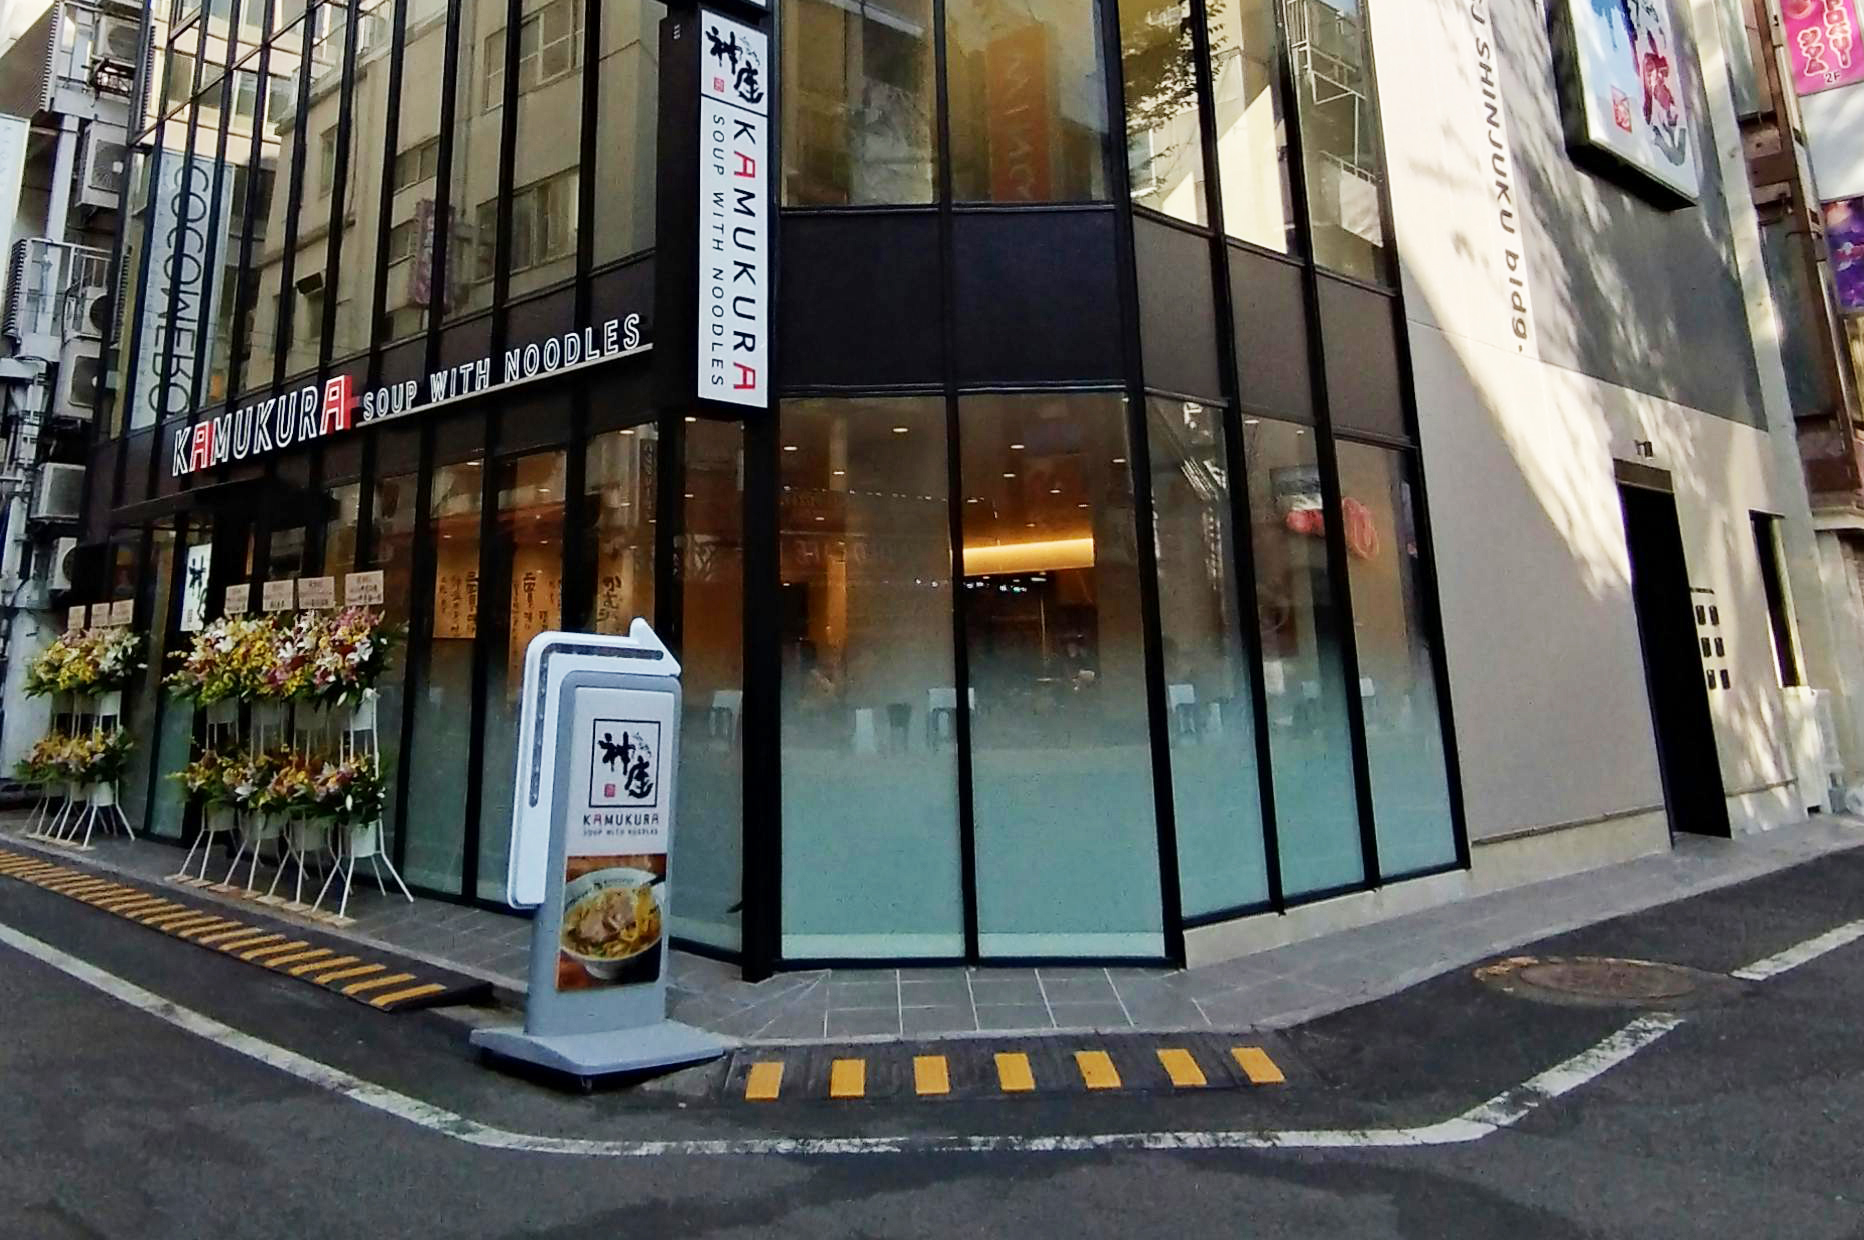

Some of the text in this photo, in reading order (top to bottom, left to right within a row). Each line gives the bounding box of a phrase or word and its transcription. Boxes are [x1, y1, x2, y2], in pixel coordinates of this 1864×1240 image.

[1825, 71, 1842, 83] 2F
[1475, 37, 1516, 234] SHINJUKU
[1504, 248, 1529, 353] bldg.
[710, 114, 725, 387] SOUP WITH NOODLES
[732, 118, 757, 391] KAMUKURA
[362, 313, 641, 422] SOUP WITH NOODLES
[172, 374, 350, 477] KAMUKURA
[583, 813, 660, 826] KAMUKURA
